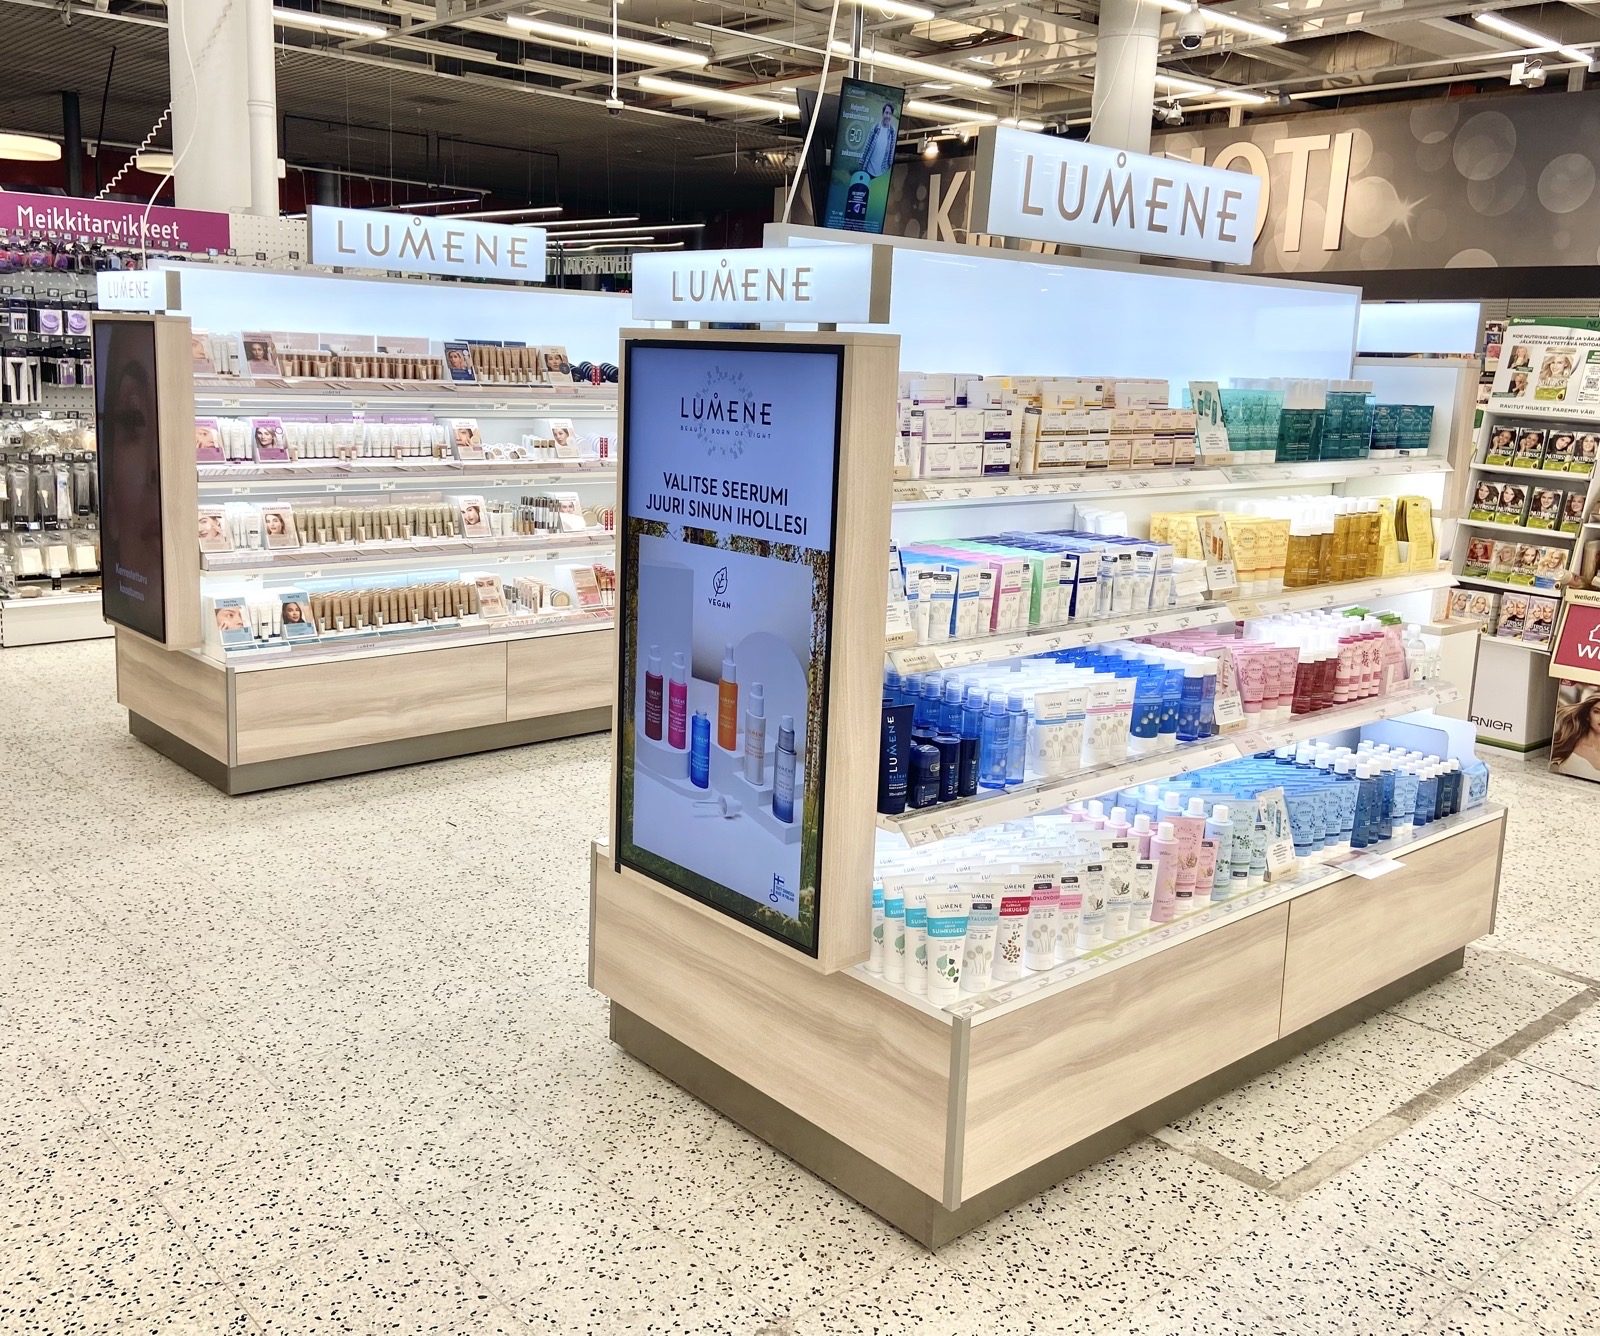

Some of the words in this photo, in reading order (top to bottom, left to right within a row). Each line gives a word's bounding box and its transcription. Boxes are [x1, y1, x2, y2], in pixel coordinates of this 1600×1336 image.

[1021, 151, 1243, 243] LUMENE
[16, 204, 180, 240] Meikkitarvikkeet
[337, 216, 529, 269] LUMENE
[107, 276, 150, 299] LUMENE
[671, 258, 813, 302] LUMENE
[679, 391, 773, 426] LUMENE
[679, 425, 708, 434] BEAUTY
[711, 427, 731, 436] BORN
[734, 430, 745, 438] OF
[662, 471, 718, 496] VALITSE
[721, 480, 788, 507] SEERUMI
[645, 493, 685, 515] JUURI
[688, 499, 733, 523] SINUN
[736, 506, 808, 536] IHOLLESI
[707, 597, 731, 610] VEGAN
[1470, 714, 1513, 733] RNIER
[886, 715, 898, 773] LUMENE
